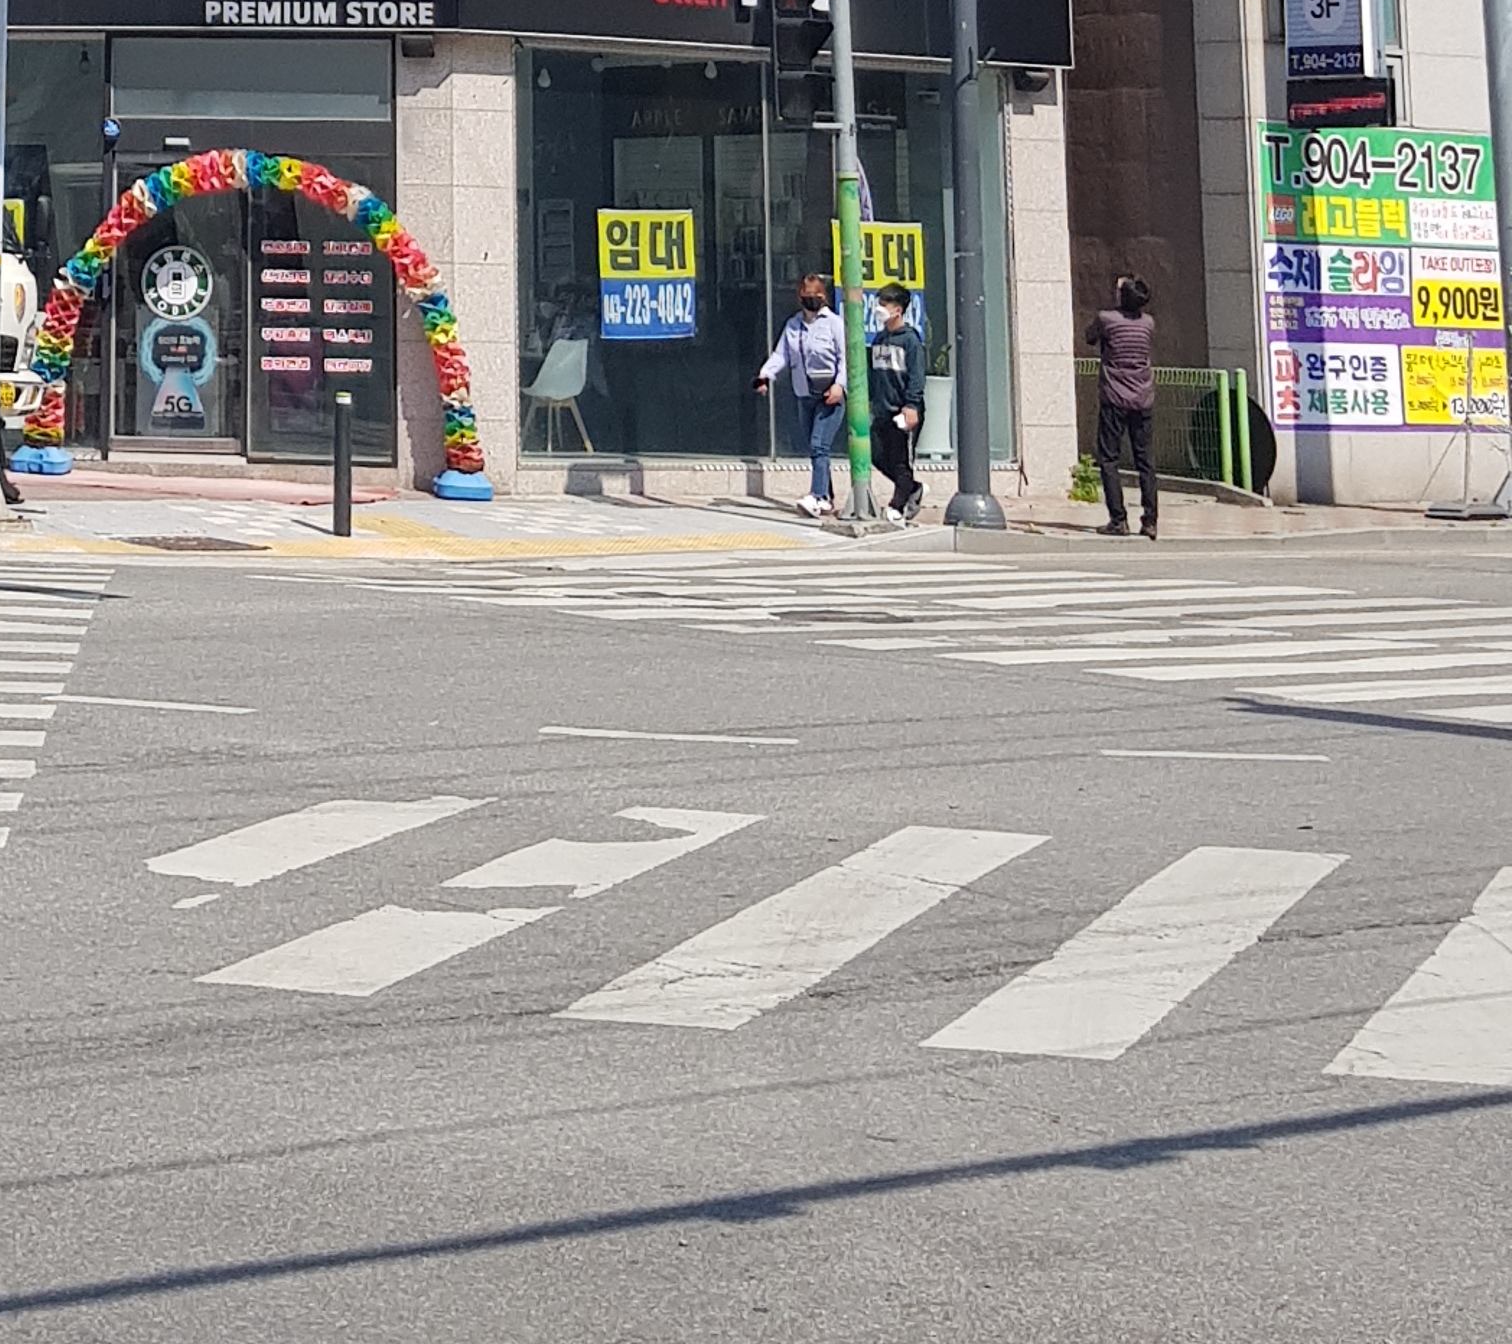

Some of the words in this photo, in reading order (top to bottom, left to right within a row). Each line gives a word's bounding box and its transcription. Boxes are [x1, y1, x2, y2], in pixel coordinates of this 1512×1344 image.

[204, 1, 338, 26] PREMIUM
[345, 0, 435, 26] STORE
[1263, 131, 1484, 191] T.904-2137
[1301, 195, 1408, 239] 레고블럭
[605, 218, 687, 272] 임대
[1327, 247, 1405, 294] 슬라임
[1417, 285, 1501, 324] 9,900원
[1306, 351, 1389, 383] 완구인증
[165, 395, 193, 412] 5G
[1308, 388, 1390, 416] 제품사용
